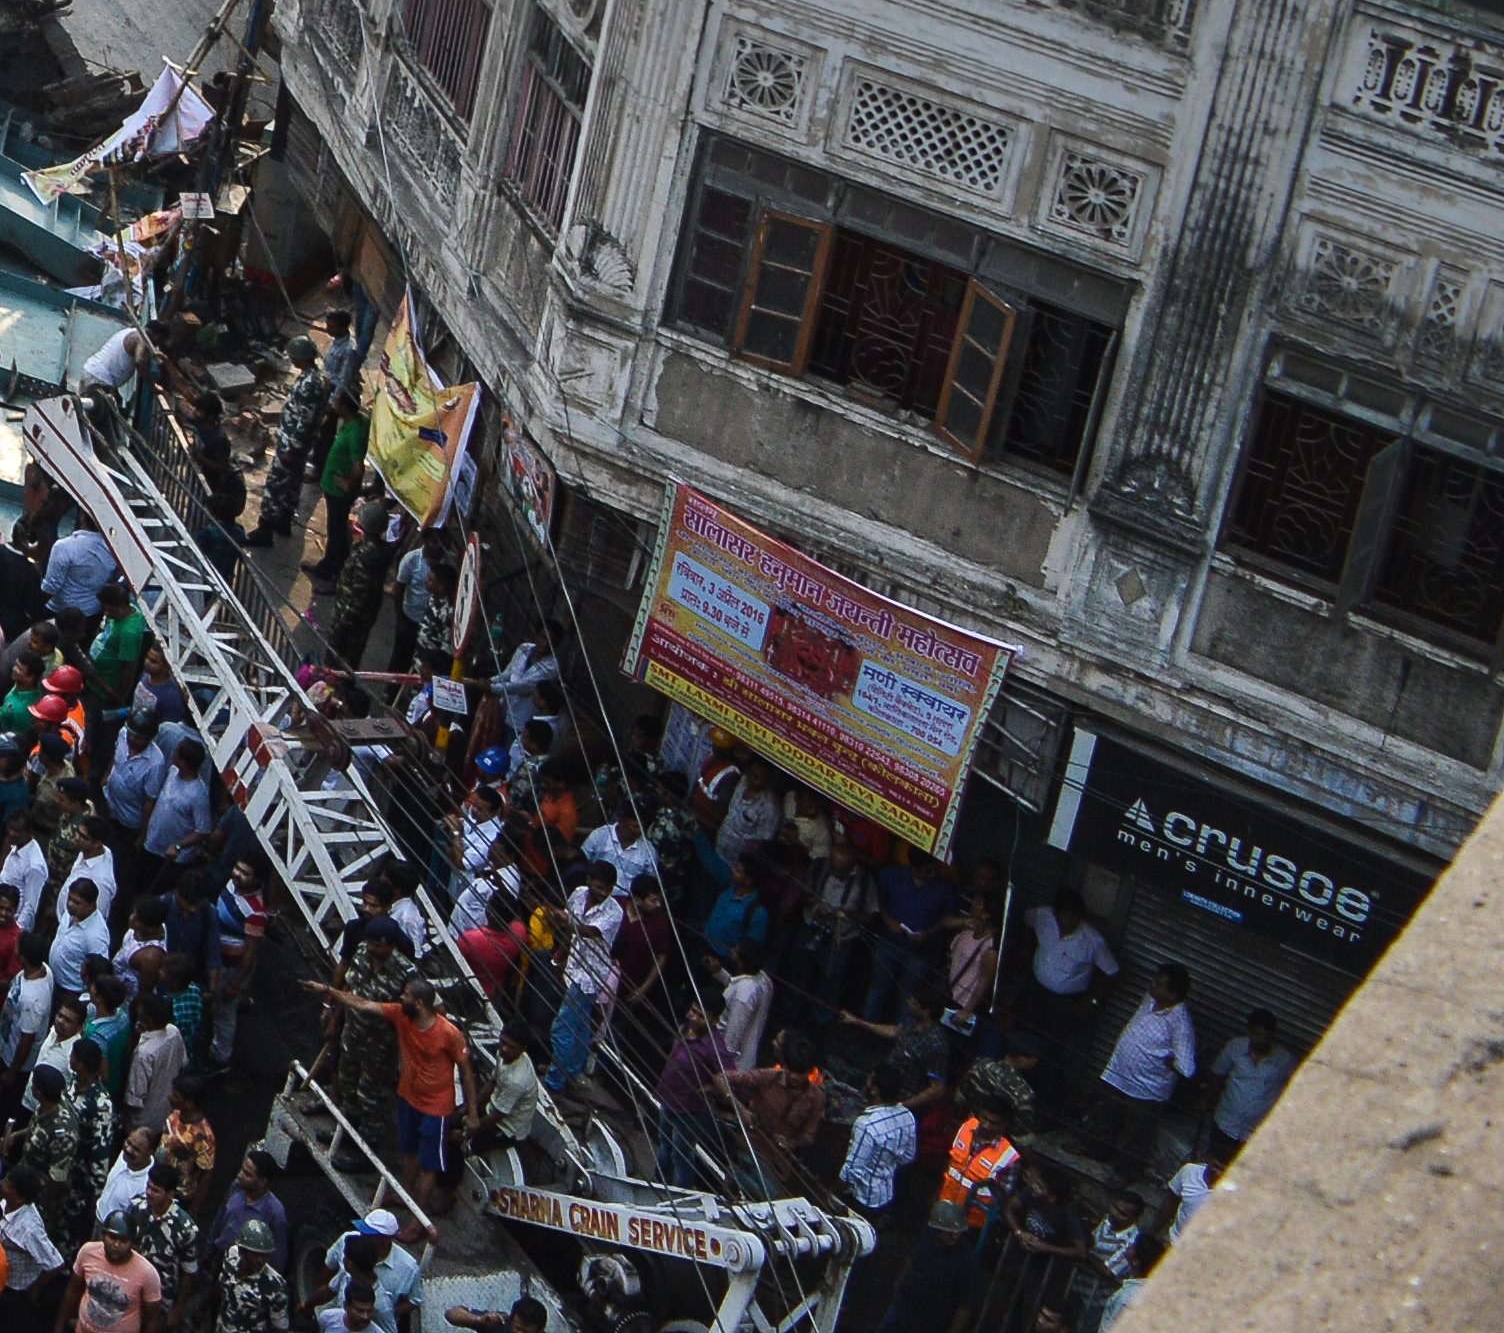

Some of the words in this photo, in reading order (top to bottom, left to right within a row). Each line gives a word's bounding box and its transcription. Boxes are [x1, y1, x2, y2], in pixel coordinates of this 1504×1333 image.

[684, 505, 758, 564] सालासर
[759, 550, 825, 605] हनुमान
[826, 590, 896, 639] जयन्ती
[896, 623, 983, 677] महोत्सव
[702, 601, 723, 623] 9.30
[741, 602, 765, 624] 2016
[652, 634, 711, 672] आयोजक
[687, 681, 731, 715] LAXMI
[734, 708, 768, 738] DEVI
[771, 731, 836, 780] PODDAR
[841, 776, 876, 804] SEVA
[879, 800, 932, 837] SADAN
[1117, 827, 1199, 873] men's
[1213, 868, 1363, 943] innerwear
[1162, 810, 1372, 923] crusoe
[498, 1187, 564, 1229] SHARMA
[568, 1202, 620, 1242] CRAIN
[628, 1217, 708, 1261] SERVICE
